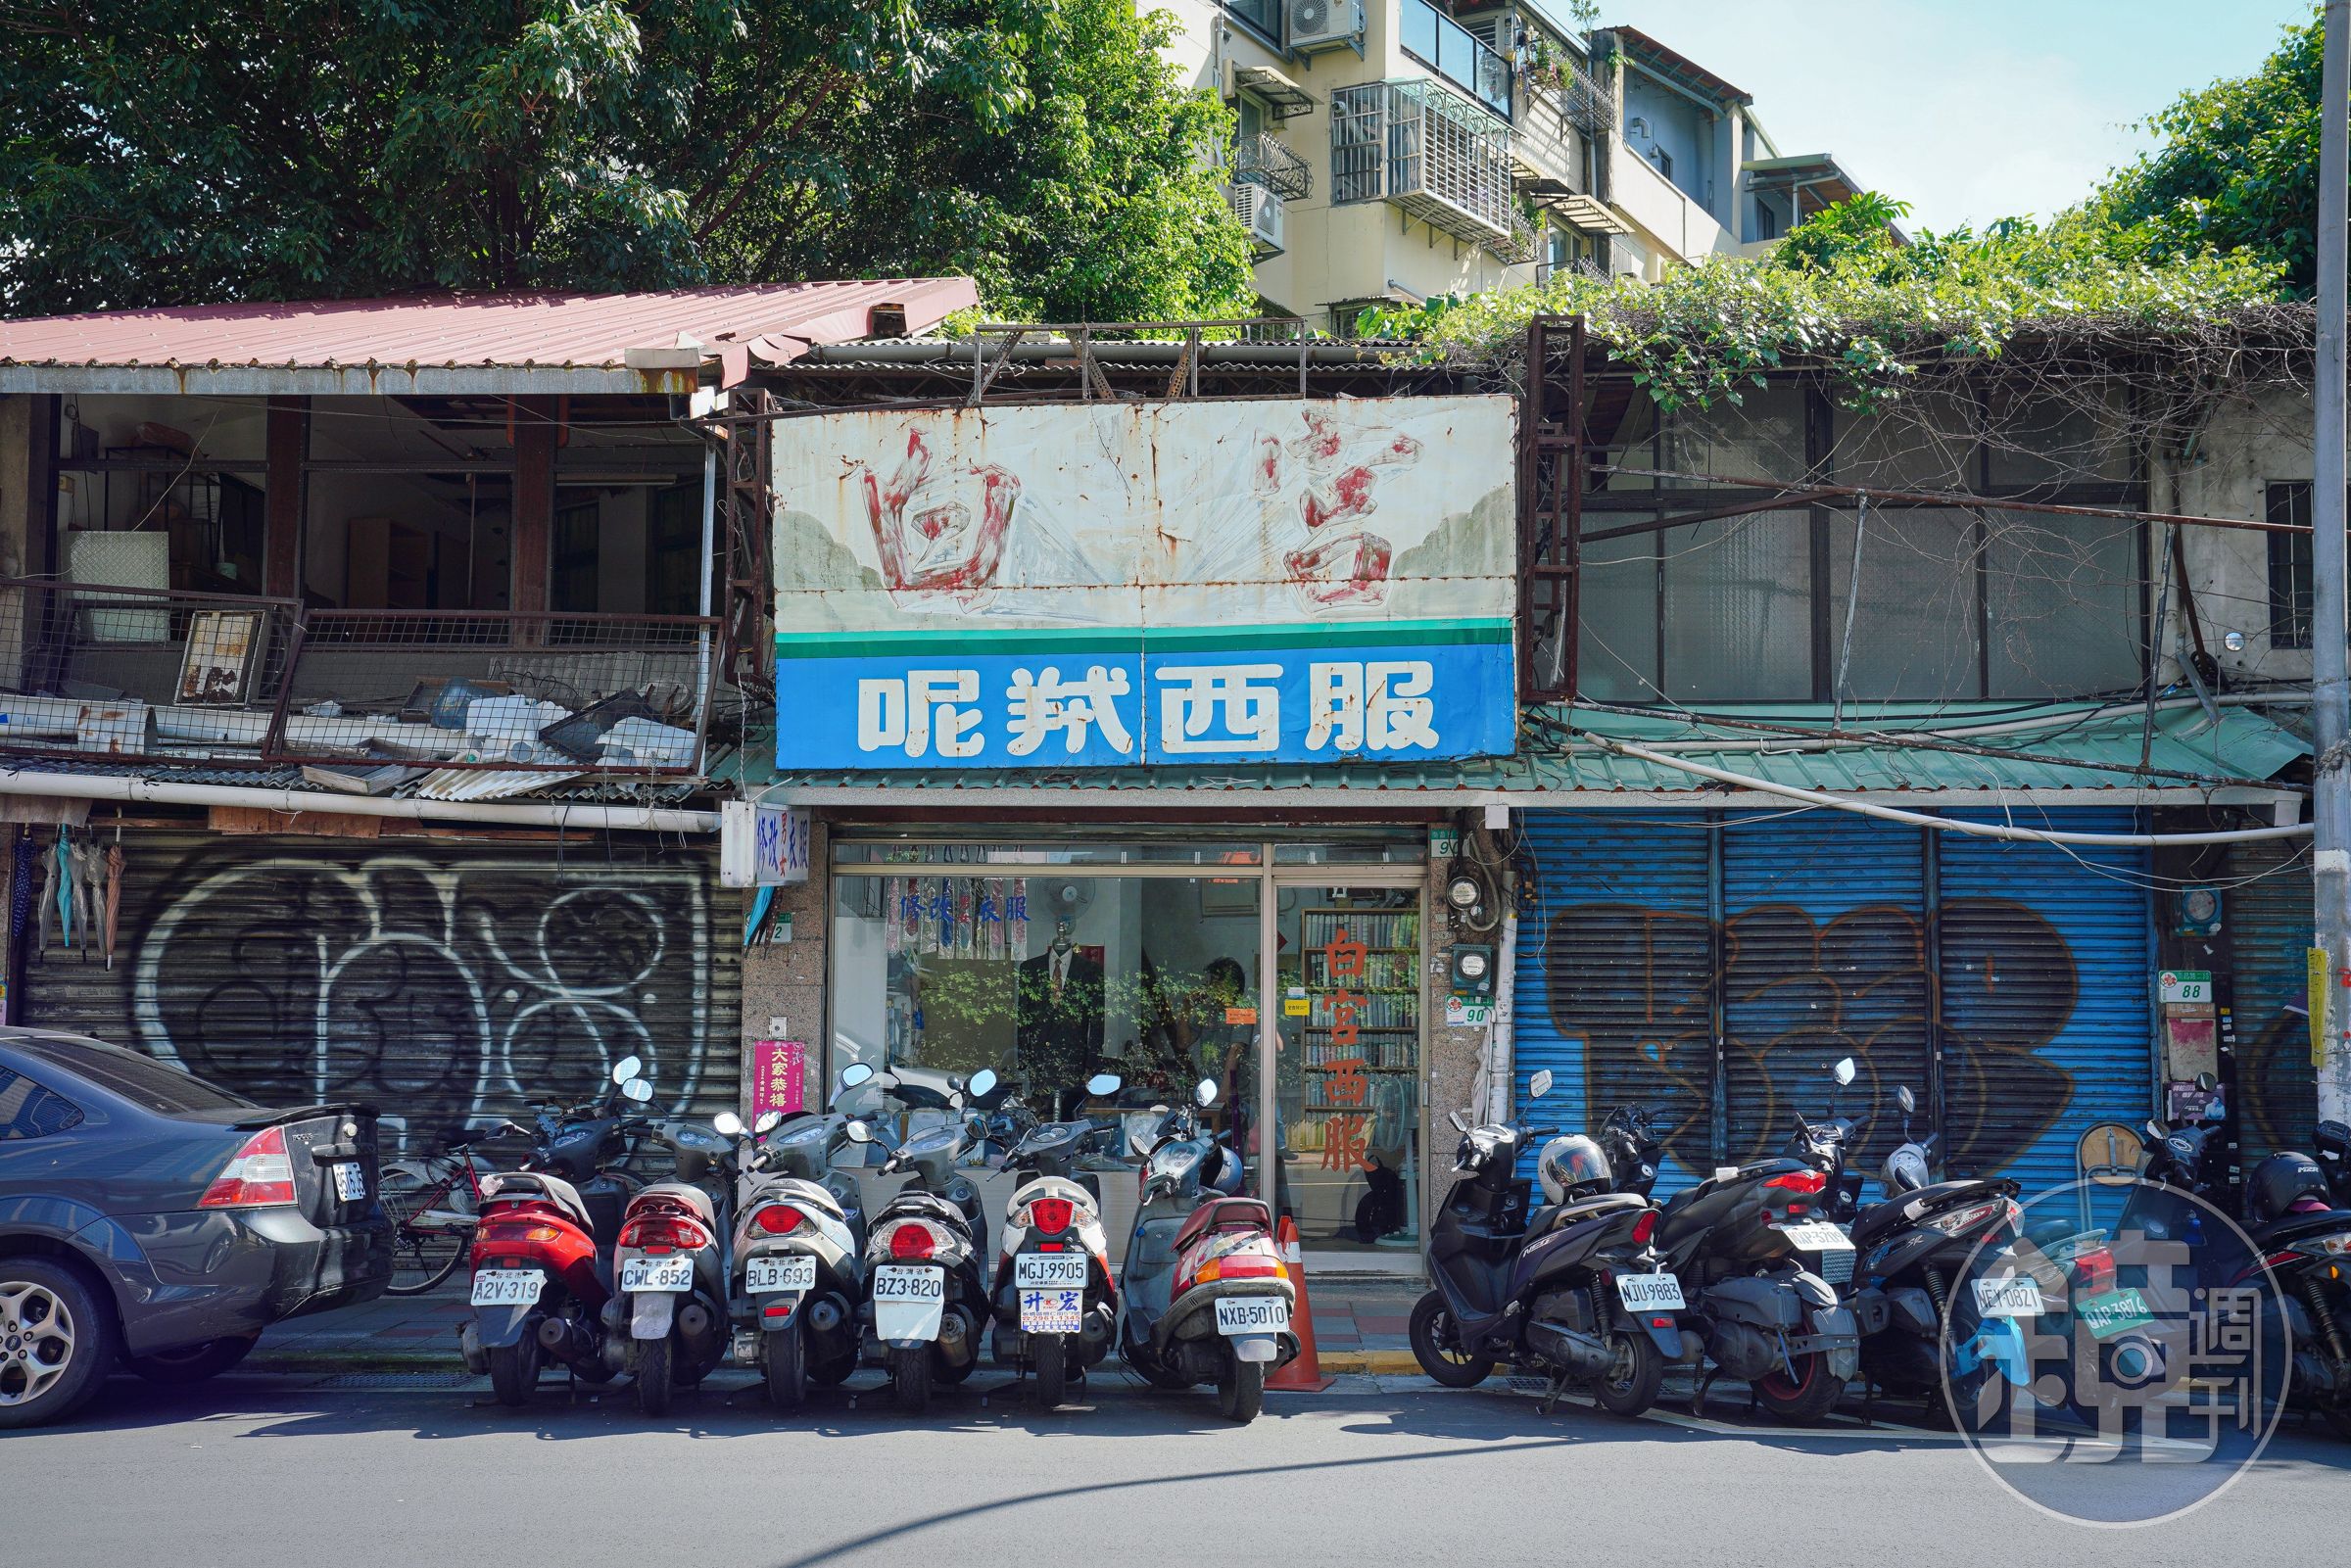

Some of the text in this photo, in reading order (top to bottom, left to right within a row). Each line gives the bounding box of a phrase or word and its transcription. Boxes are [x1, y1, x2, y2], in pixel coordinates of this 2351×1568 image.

[2183, 984, 2201, 998] 88
[1466, 1009, 1484, 1022] 90
[1320, 927, 1378, 1173] 白宮西服
[769, 1048, 789, 1107] 大家恭禧
